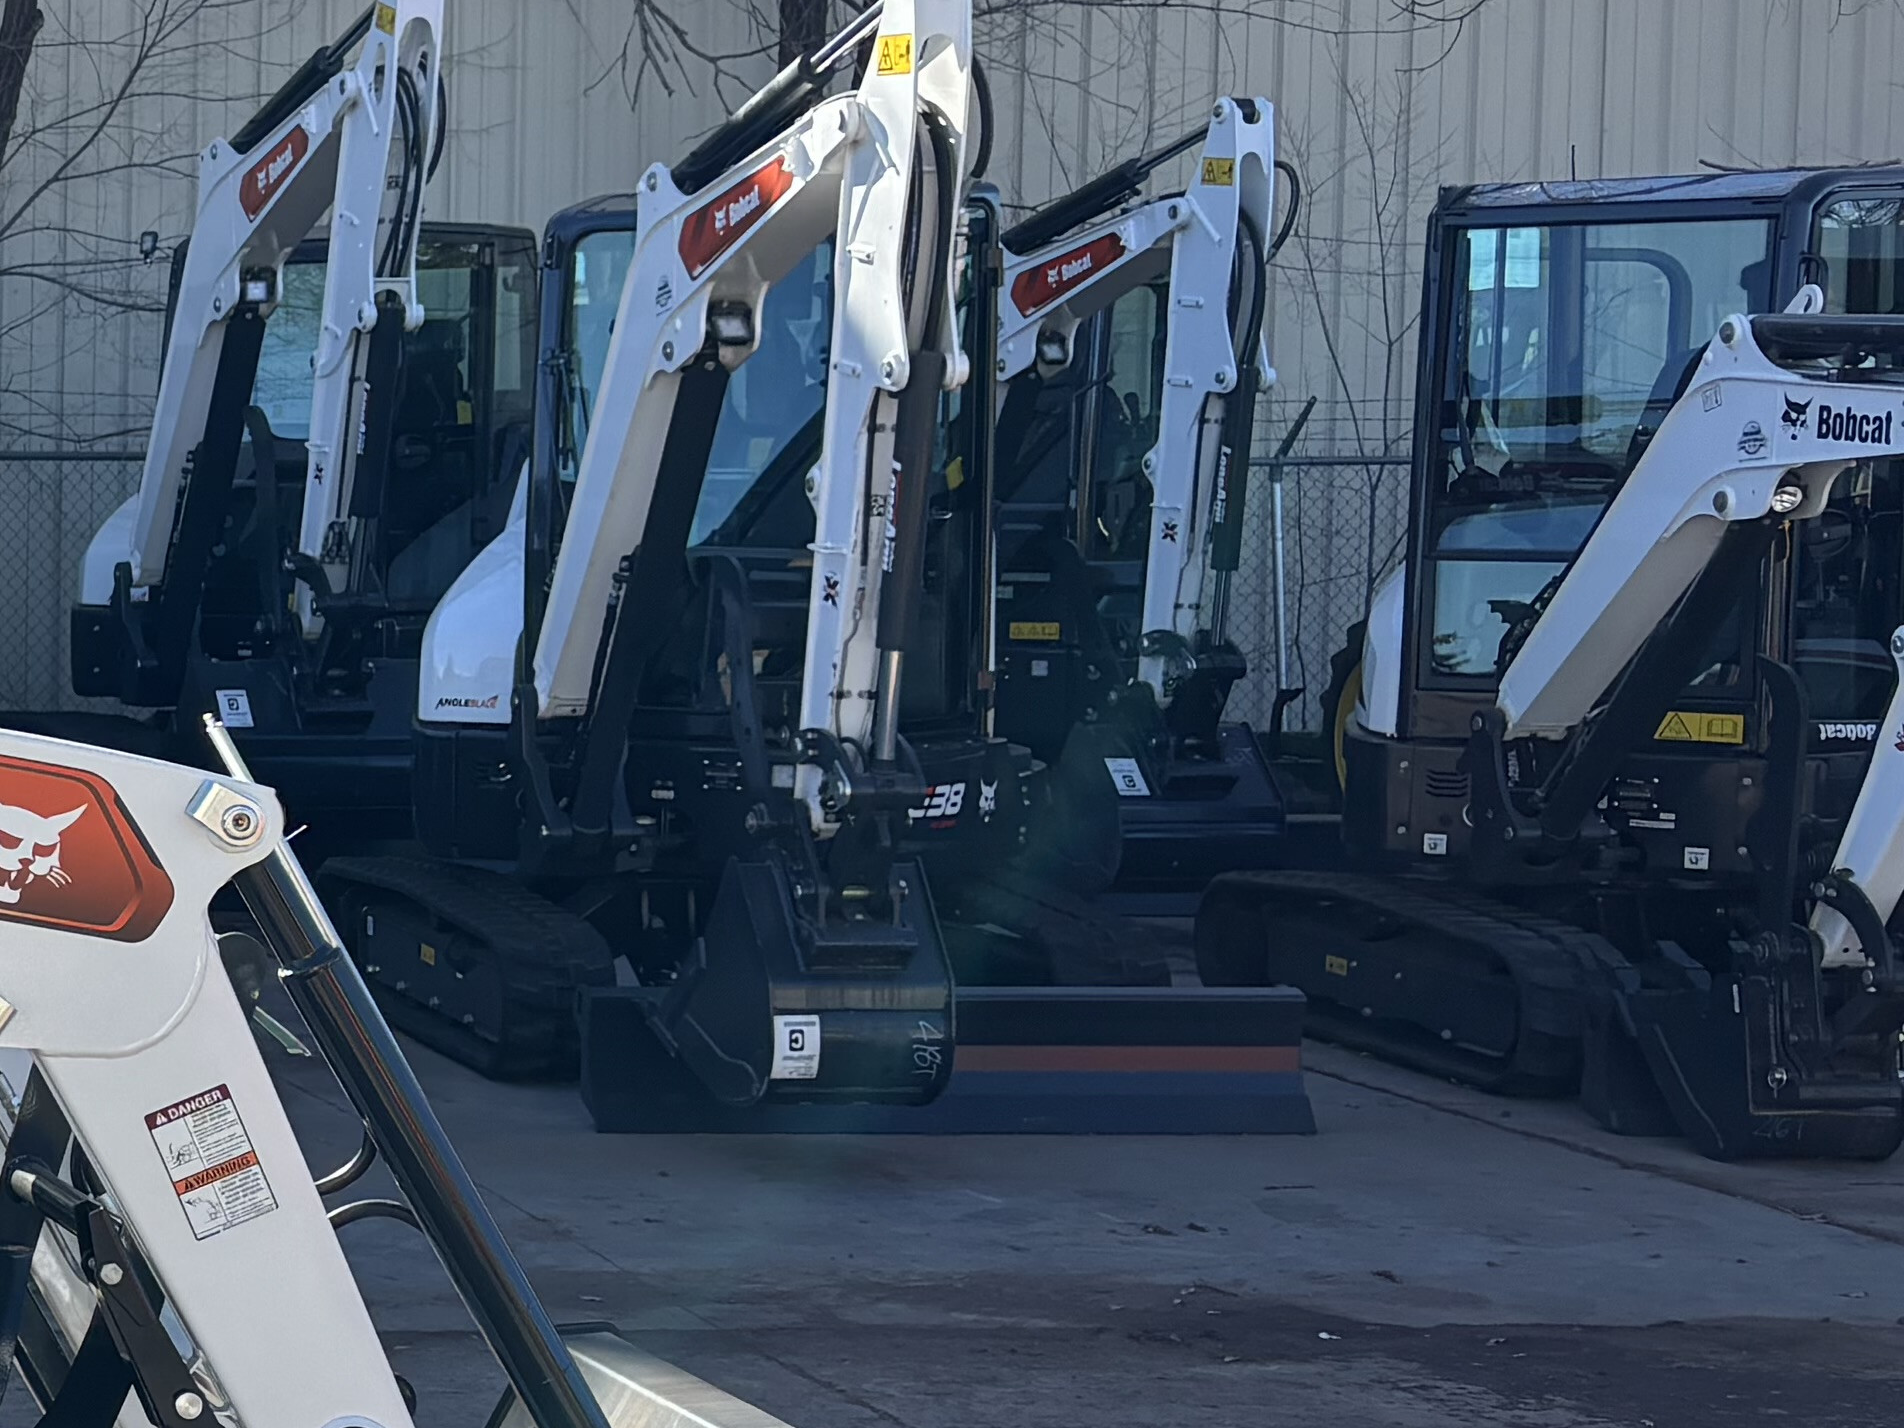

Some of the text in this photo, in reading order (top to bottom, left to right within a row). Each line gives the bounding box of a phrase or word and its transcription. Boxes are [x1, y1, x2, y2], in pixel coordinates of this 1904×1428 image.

[729, 184, 760, 226] Bobcat
[1061, 253, 1091, 281] Bobcat
[1816, 405, 1893, 445] Bobcat
[168, 1089, 223, 1120] DANGER
[192, 1155, 252, 1187] WARNING
